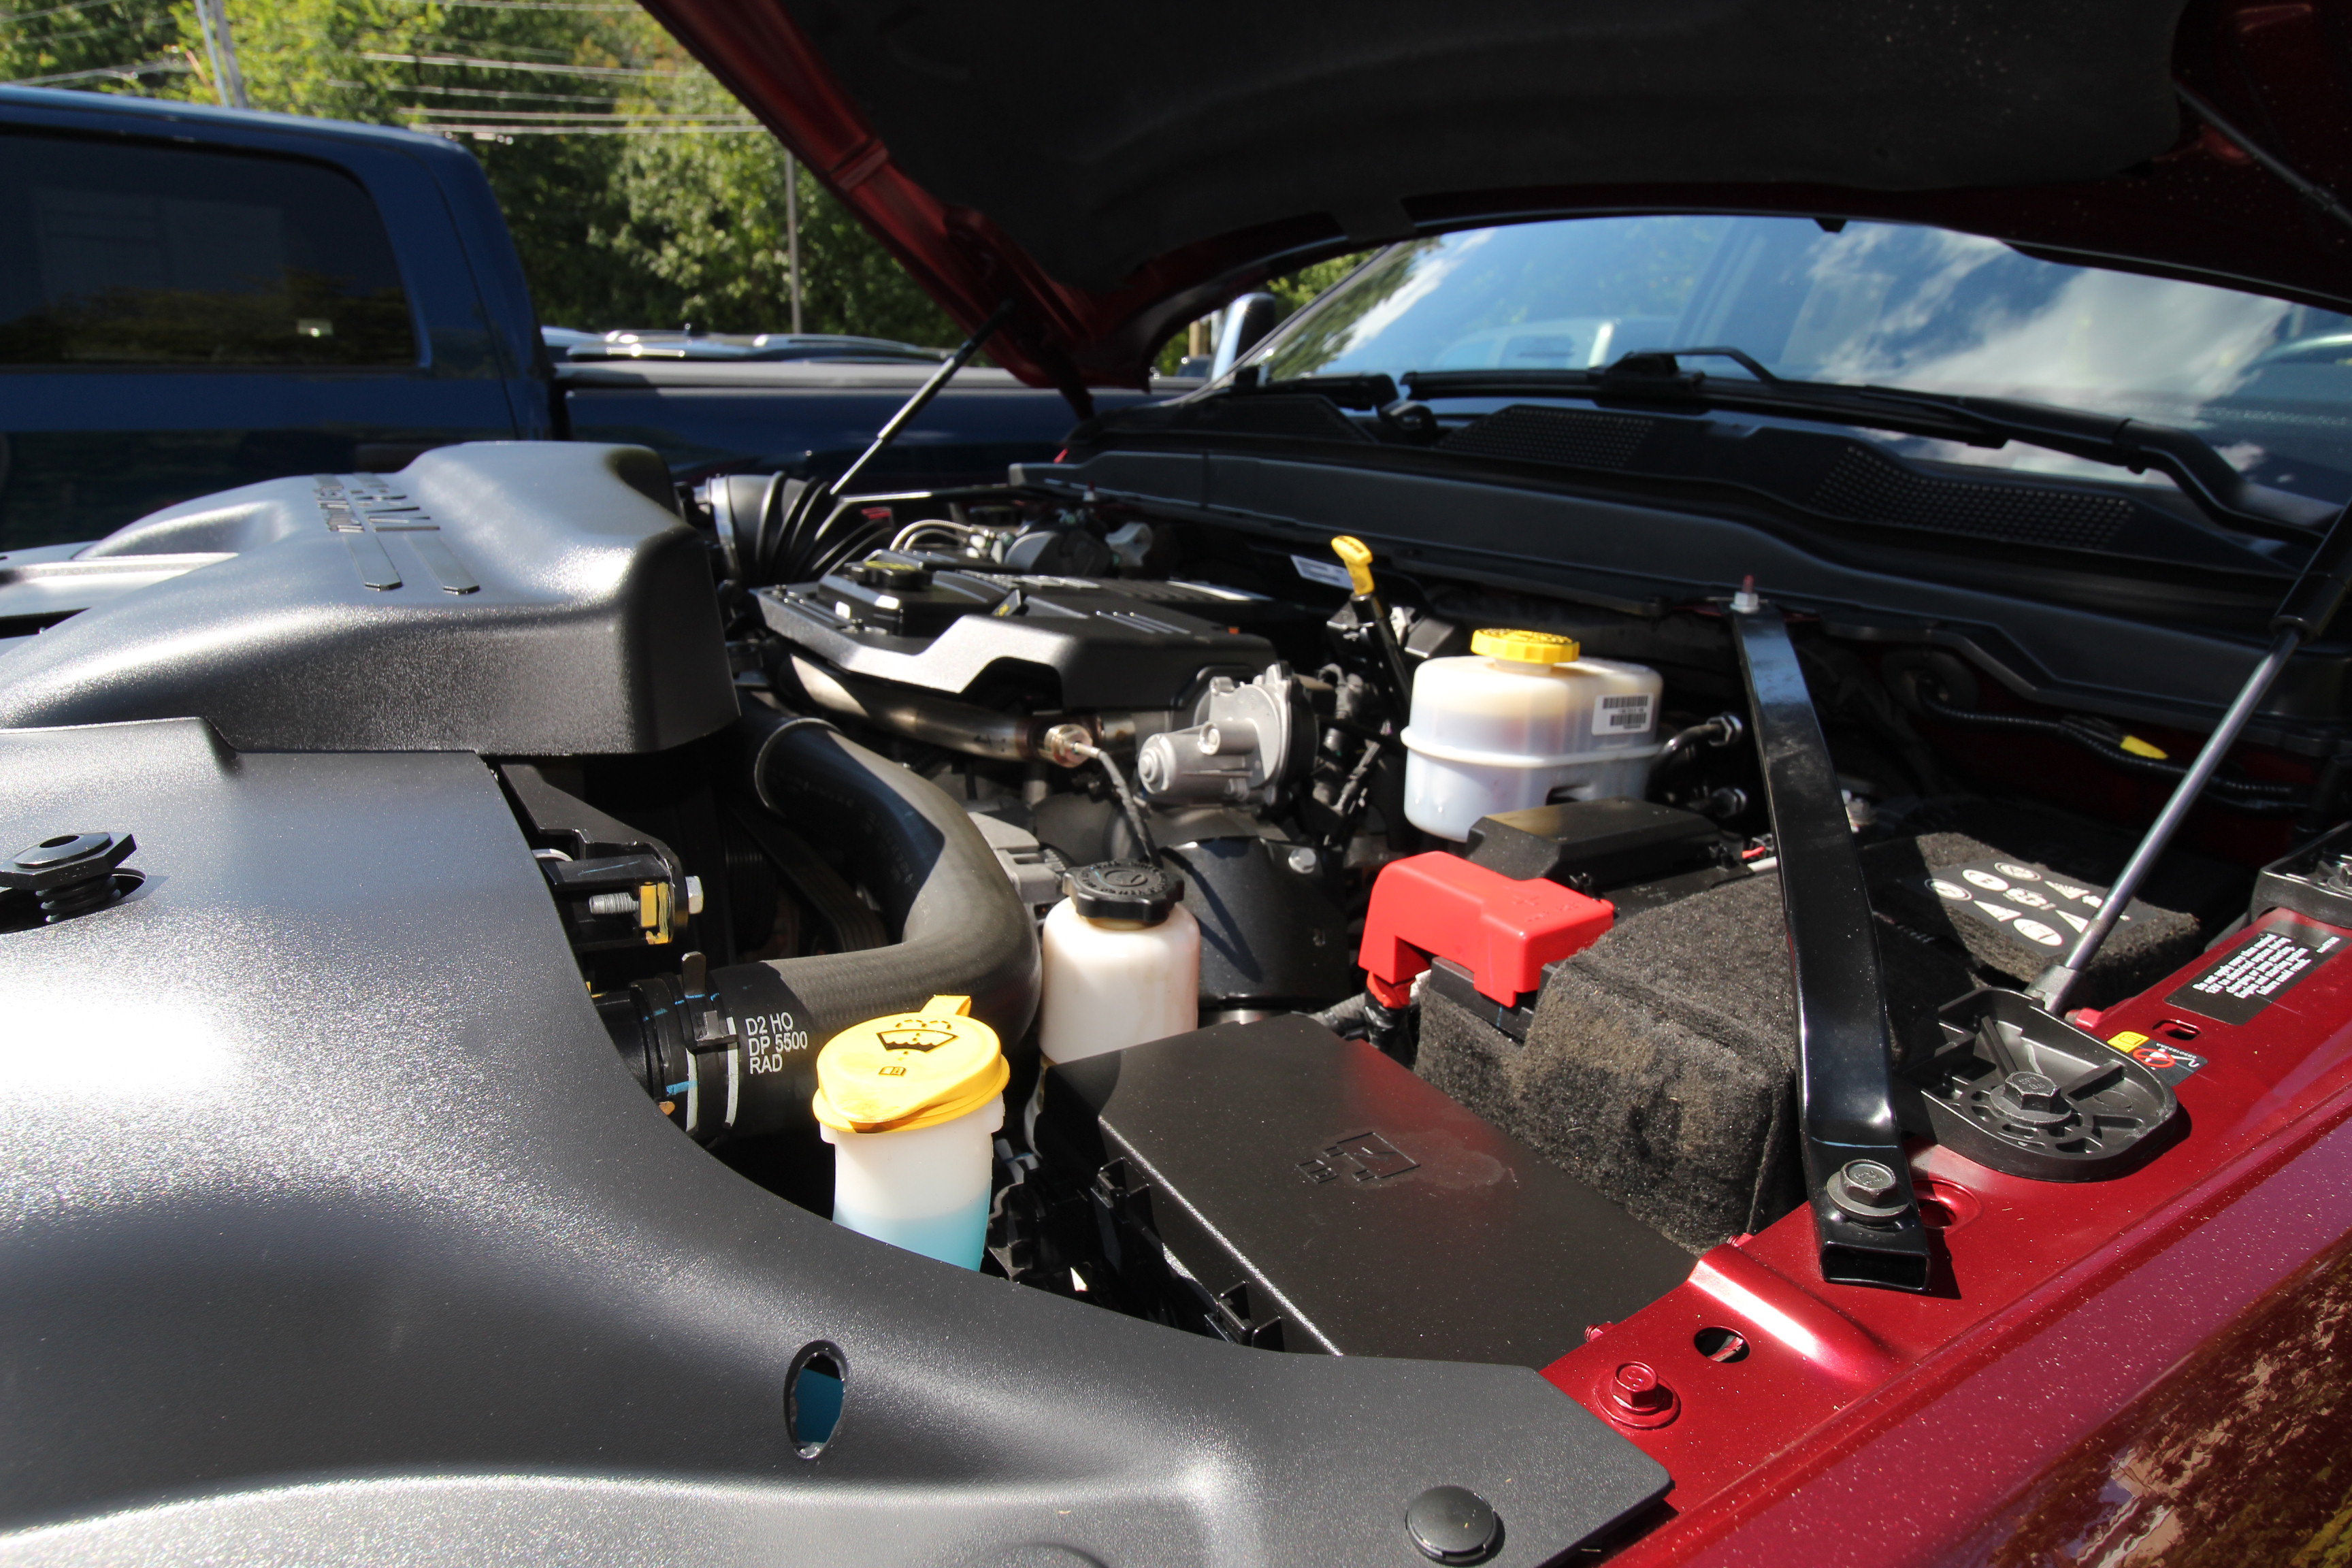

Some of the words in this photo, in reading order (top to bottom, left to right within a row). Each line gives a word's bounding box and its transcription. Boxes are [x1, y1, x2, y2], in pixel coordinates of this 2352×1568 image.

[745, 1016, 768, 1036] D2
[749, 1035, 771, 1056] DP
[775, 1030, 808, 1053] 5500
[750, 1053, 783, 1074] RAD
